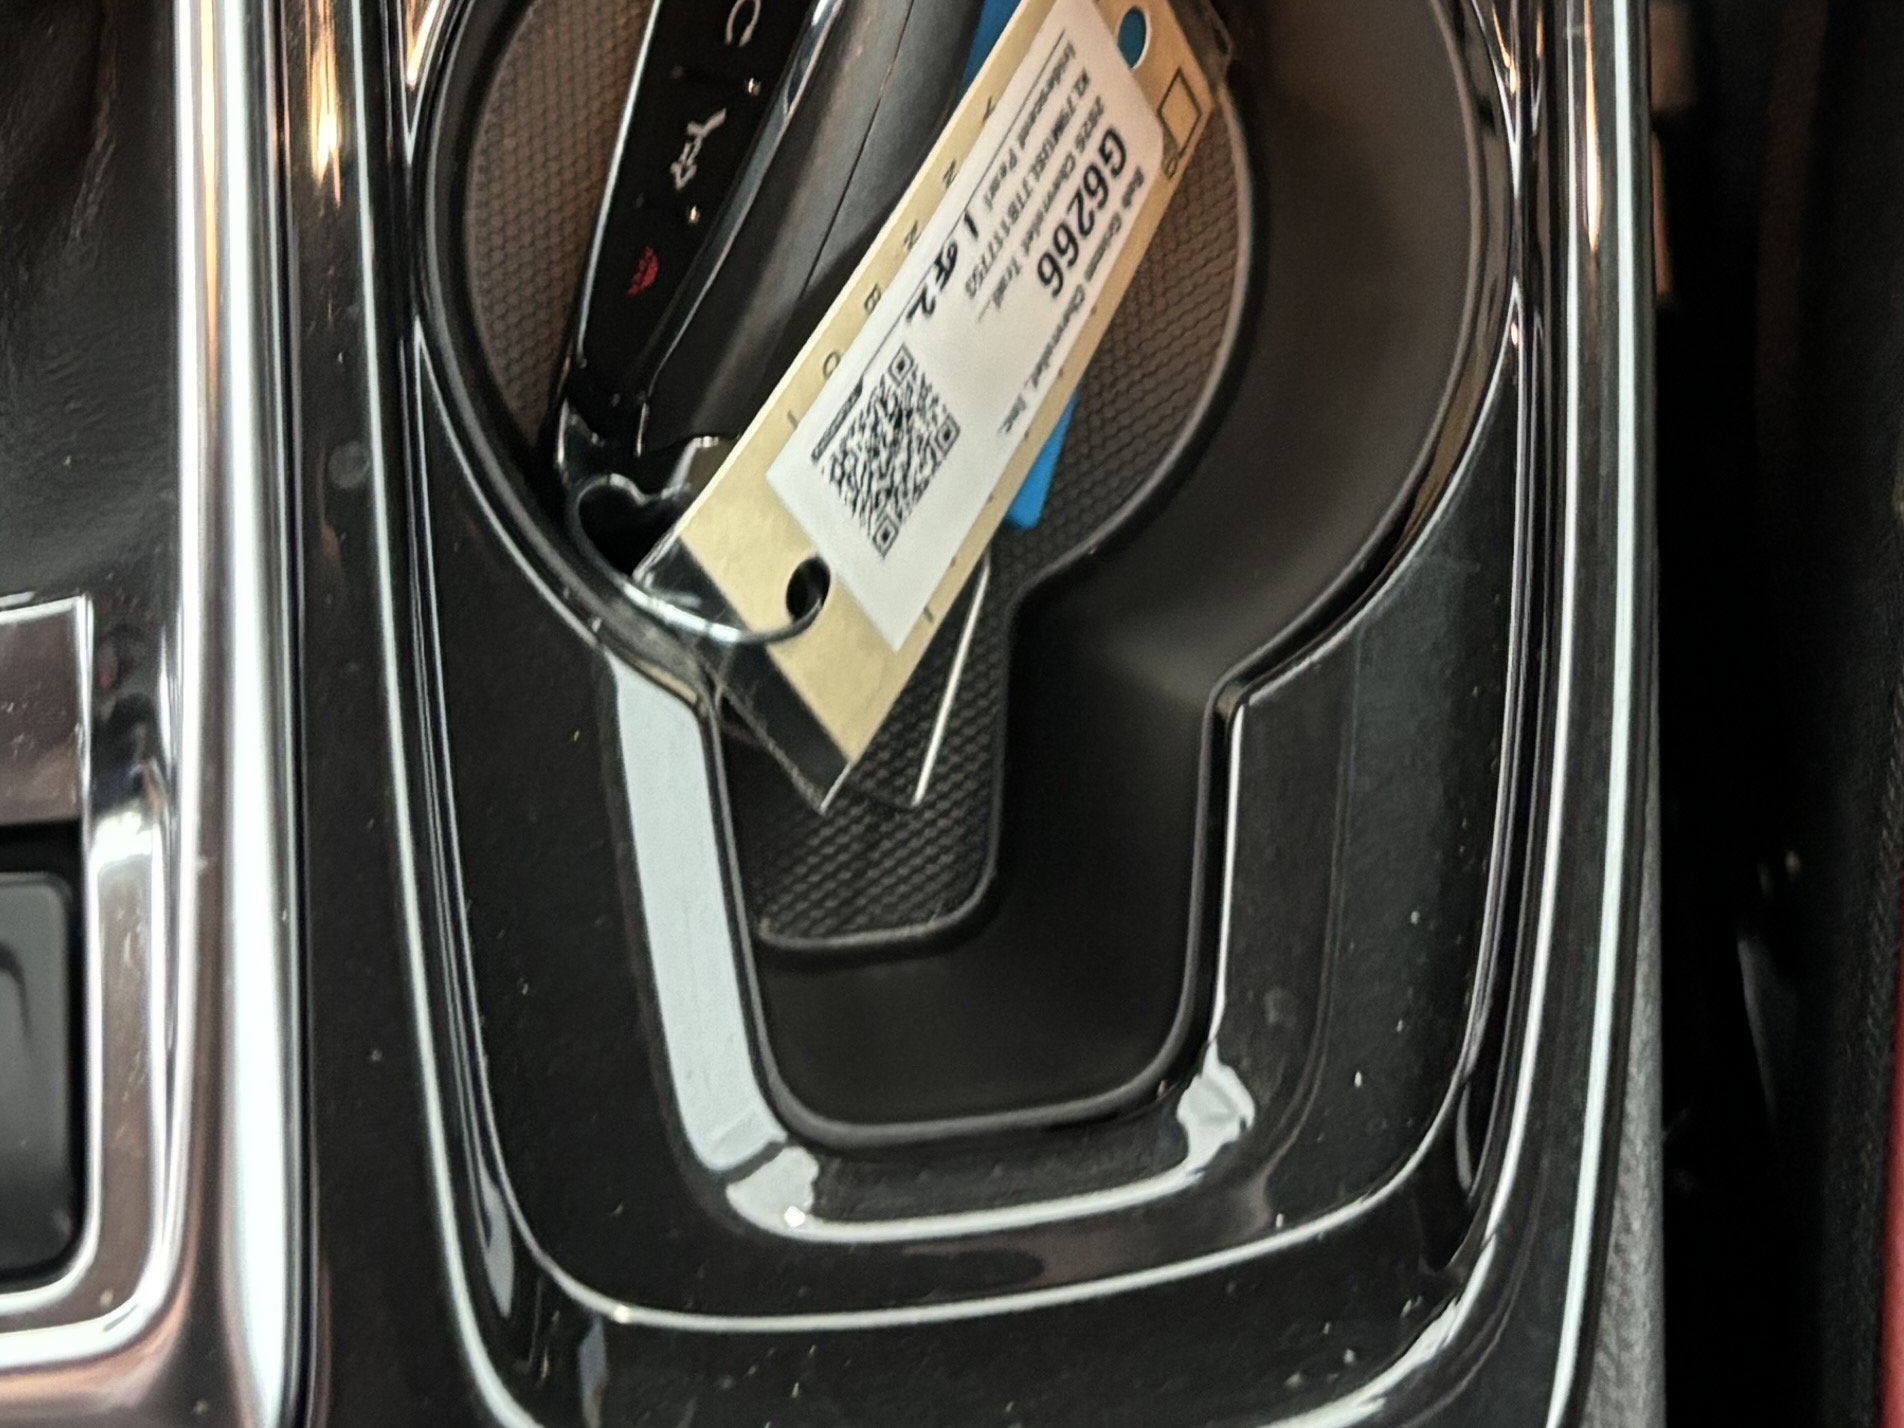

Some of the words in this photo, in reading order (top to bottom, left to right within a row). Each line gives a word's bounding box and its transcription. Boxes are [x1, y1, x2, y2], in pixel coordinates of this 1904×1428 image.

[1016, 39, 1076, 150] Iridescent
[983, 147, 1018, 211] Pearl
[1020, 151, 1076, 256] Chevrolet
[1034, 124, 1129, 300] G6266
[905, 285, 936, 322] 2
